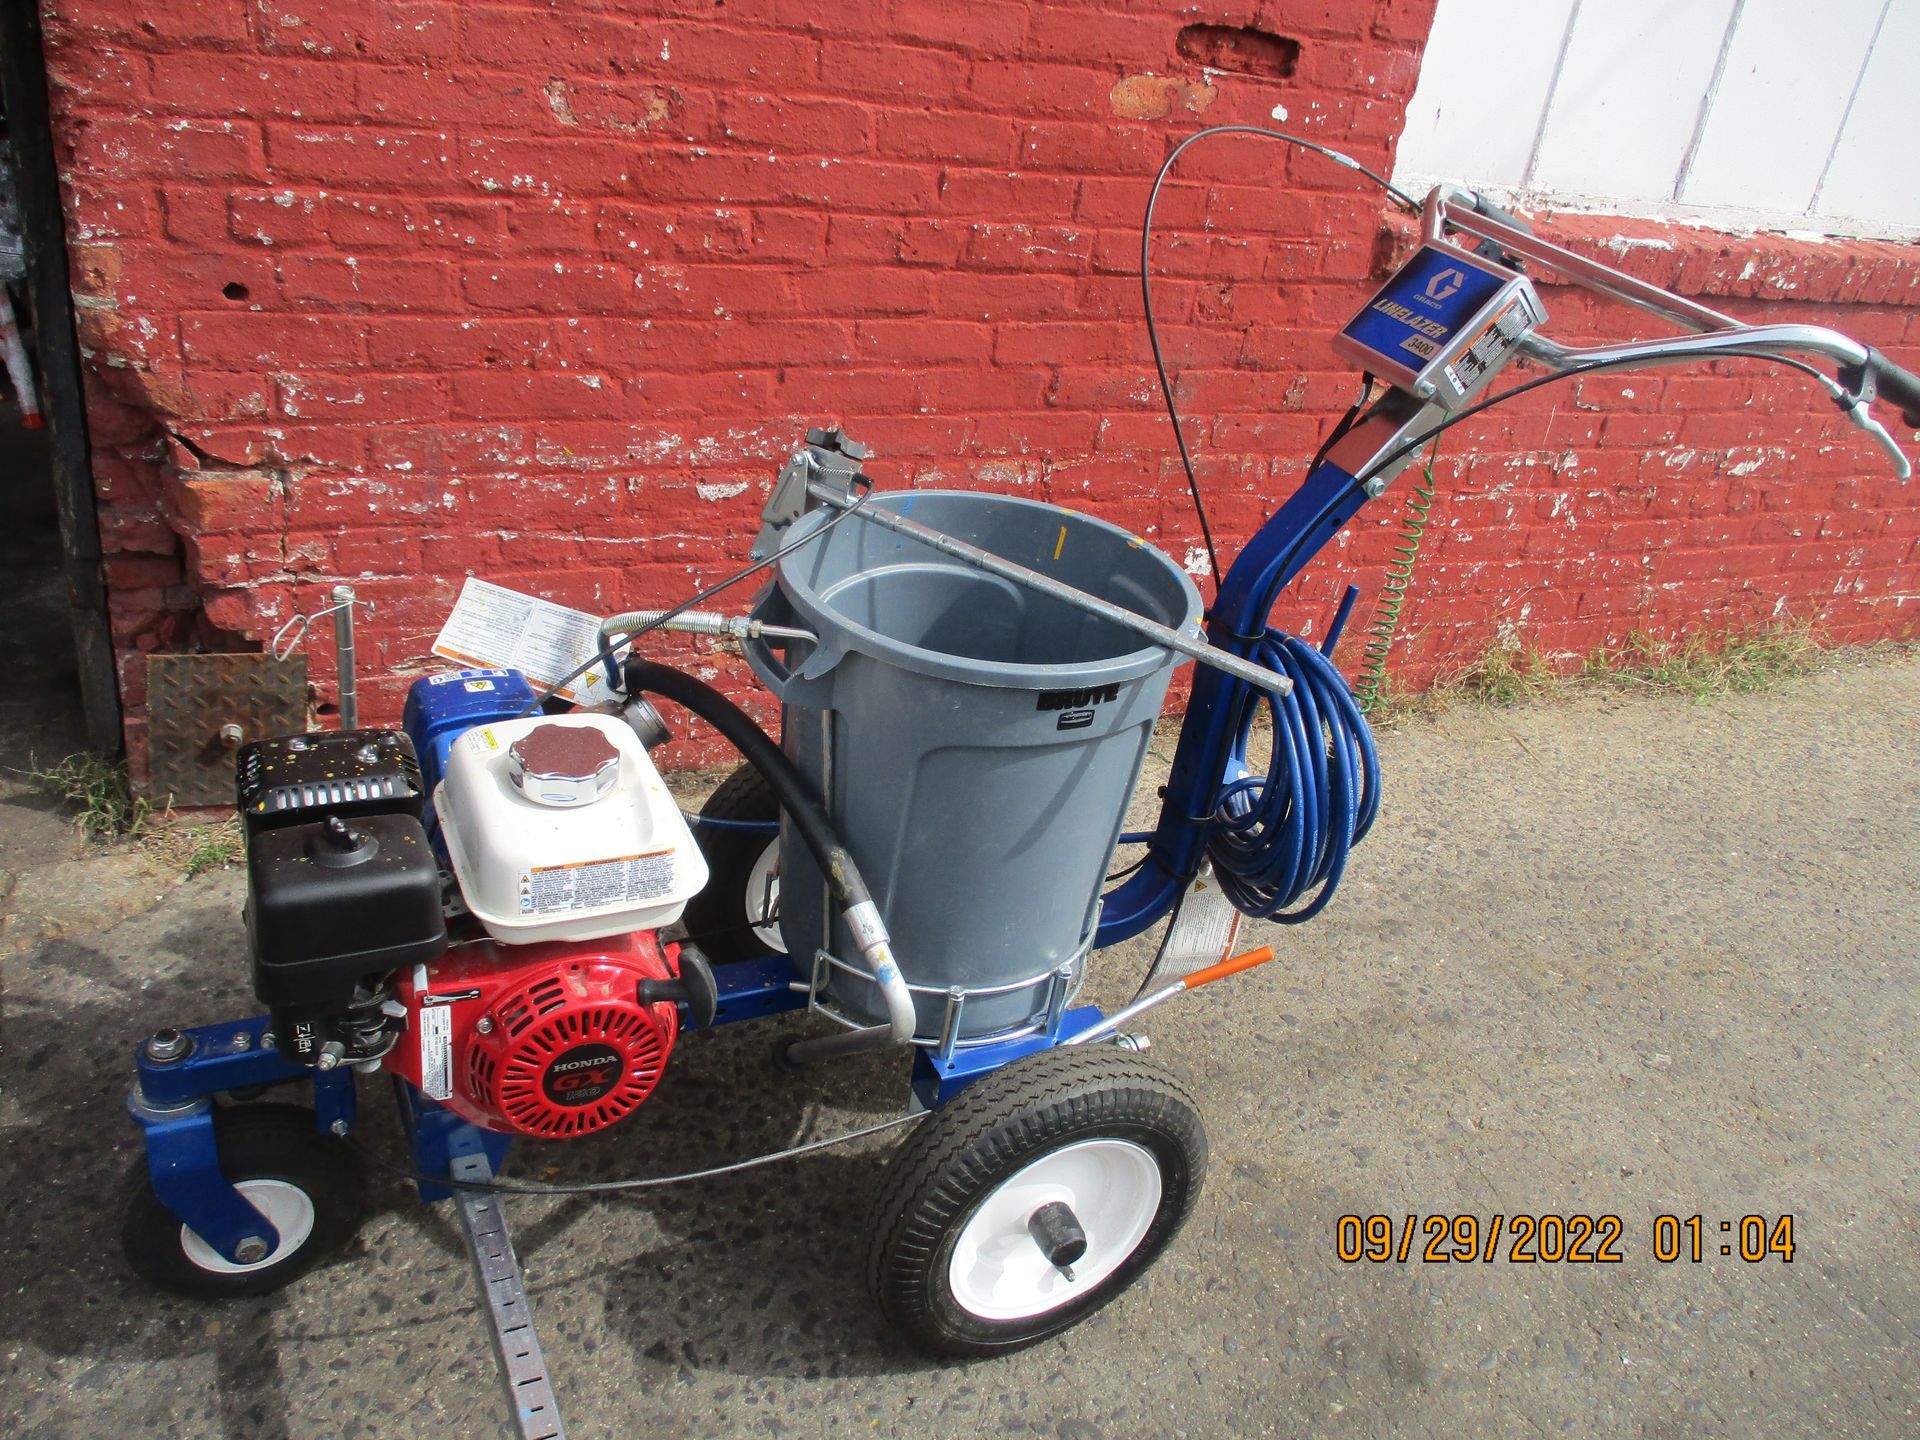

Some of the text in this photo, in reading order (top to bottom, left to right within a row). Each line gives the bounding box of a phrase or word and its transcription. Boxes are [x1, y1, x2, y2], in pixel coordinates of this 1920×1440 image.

[1412, 293, 1442, 310] GRACO
[1372, 298, 1448, 339] LINELAZER
[1407, 337, 1434, 356] 3400
[552, 1055, 618, 1073] HONDA
[553, 1066, 615, 1091] GX
